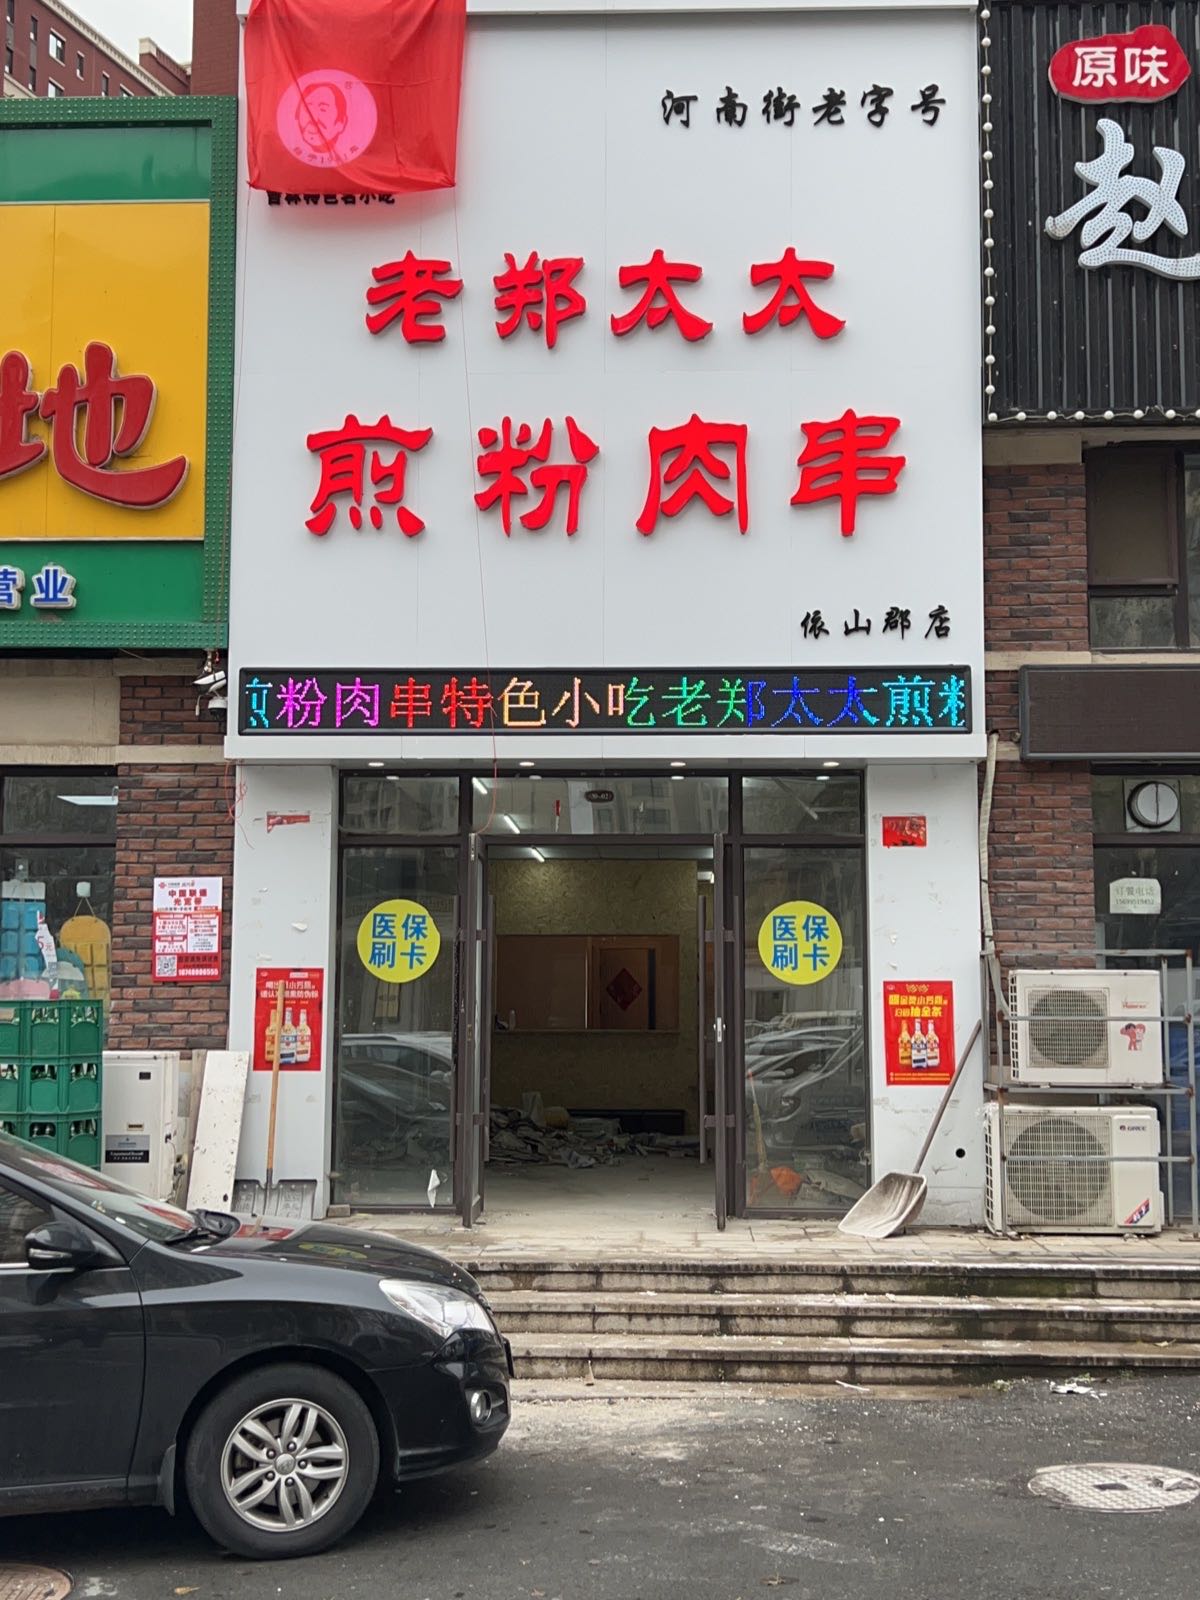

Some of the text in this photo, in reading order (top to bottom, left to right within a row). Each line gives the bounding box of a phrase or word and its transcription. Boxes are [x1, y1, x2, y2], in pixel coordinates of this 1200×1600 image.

[1073, 46, 1169, 88] 原味
[661, 84, 946, 128] 河南街老字号
[1044, 118, 1200, 281] 赵
[366, 247, 846, 349] 老郑太太
[305, 408, 907, 538] 煎粉肉串
[800, 605, 950, 640] 依山郡店
[371, 913, 428, 940] 医保
[772, 914, 829, 941] 医保
[368, 942, 427, 970] 刷卡
[771, 942, 830, 971] 刷卡
